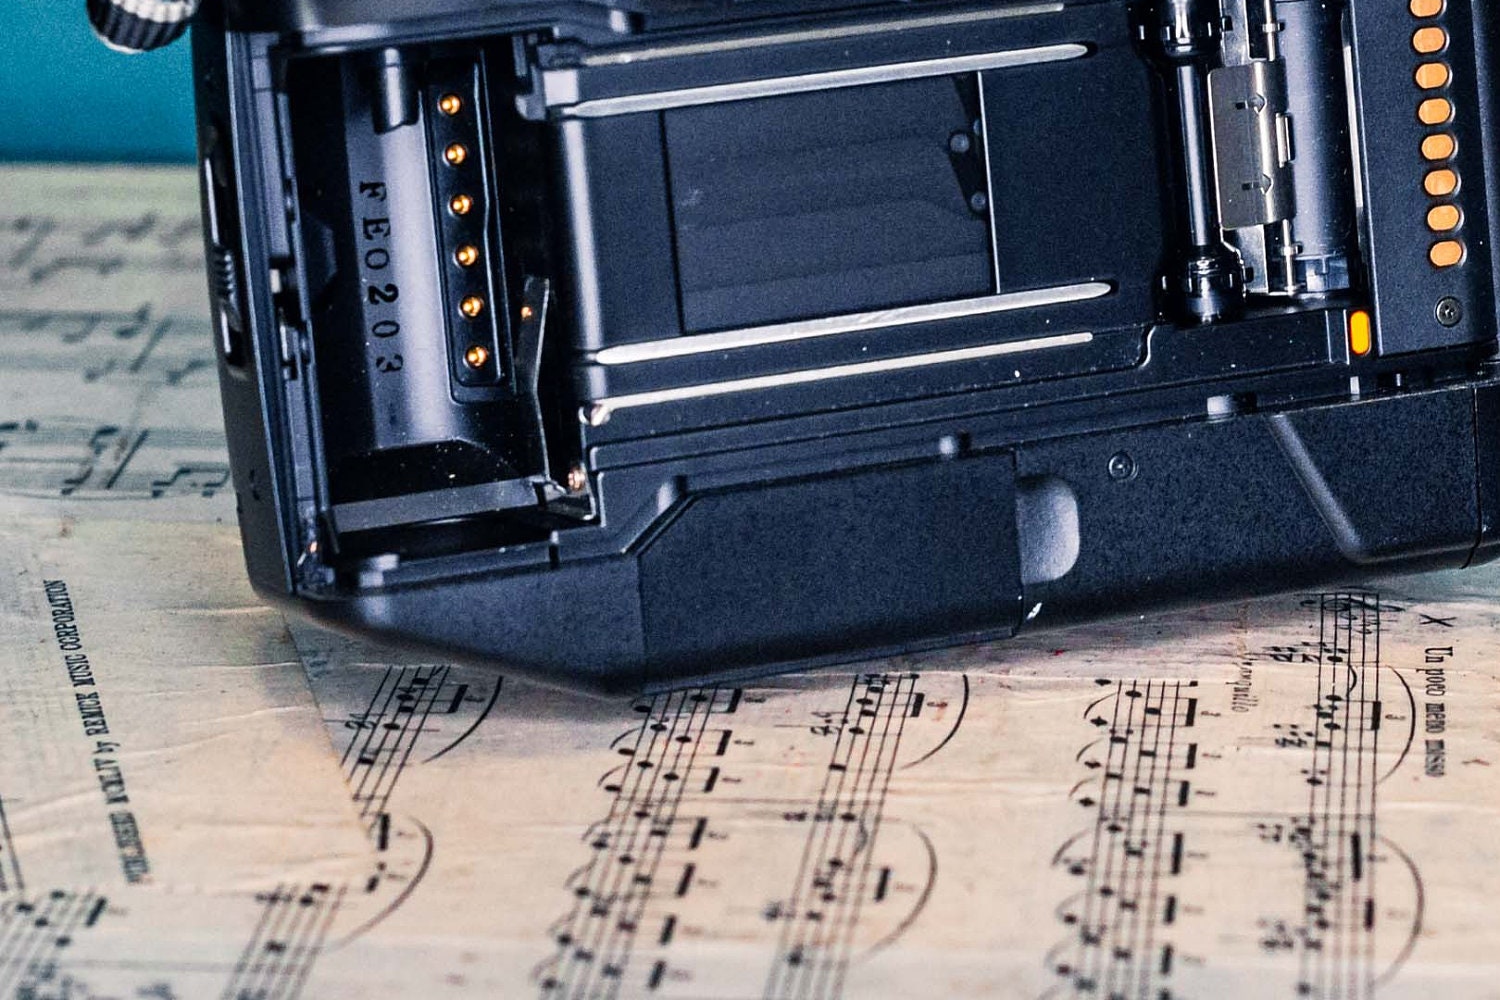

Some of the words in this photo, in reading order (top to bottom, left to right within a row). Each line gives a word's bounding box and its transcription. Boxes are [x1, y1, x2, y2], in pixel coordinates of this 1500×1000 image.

[43, 579, 82, 651] CORPORATION
[65, 653, 95, 687] MUSIC
[1424, 646, 1453, 663] Un
[1415, 668, 1446, 696] poco
[75, 691, 109, 736] REMICK
[1425, 702, 1446, 734] meno
[92, 741, 120, 754] by
